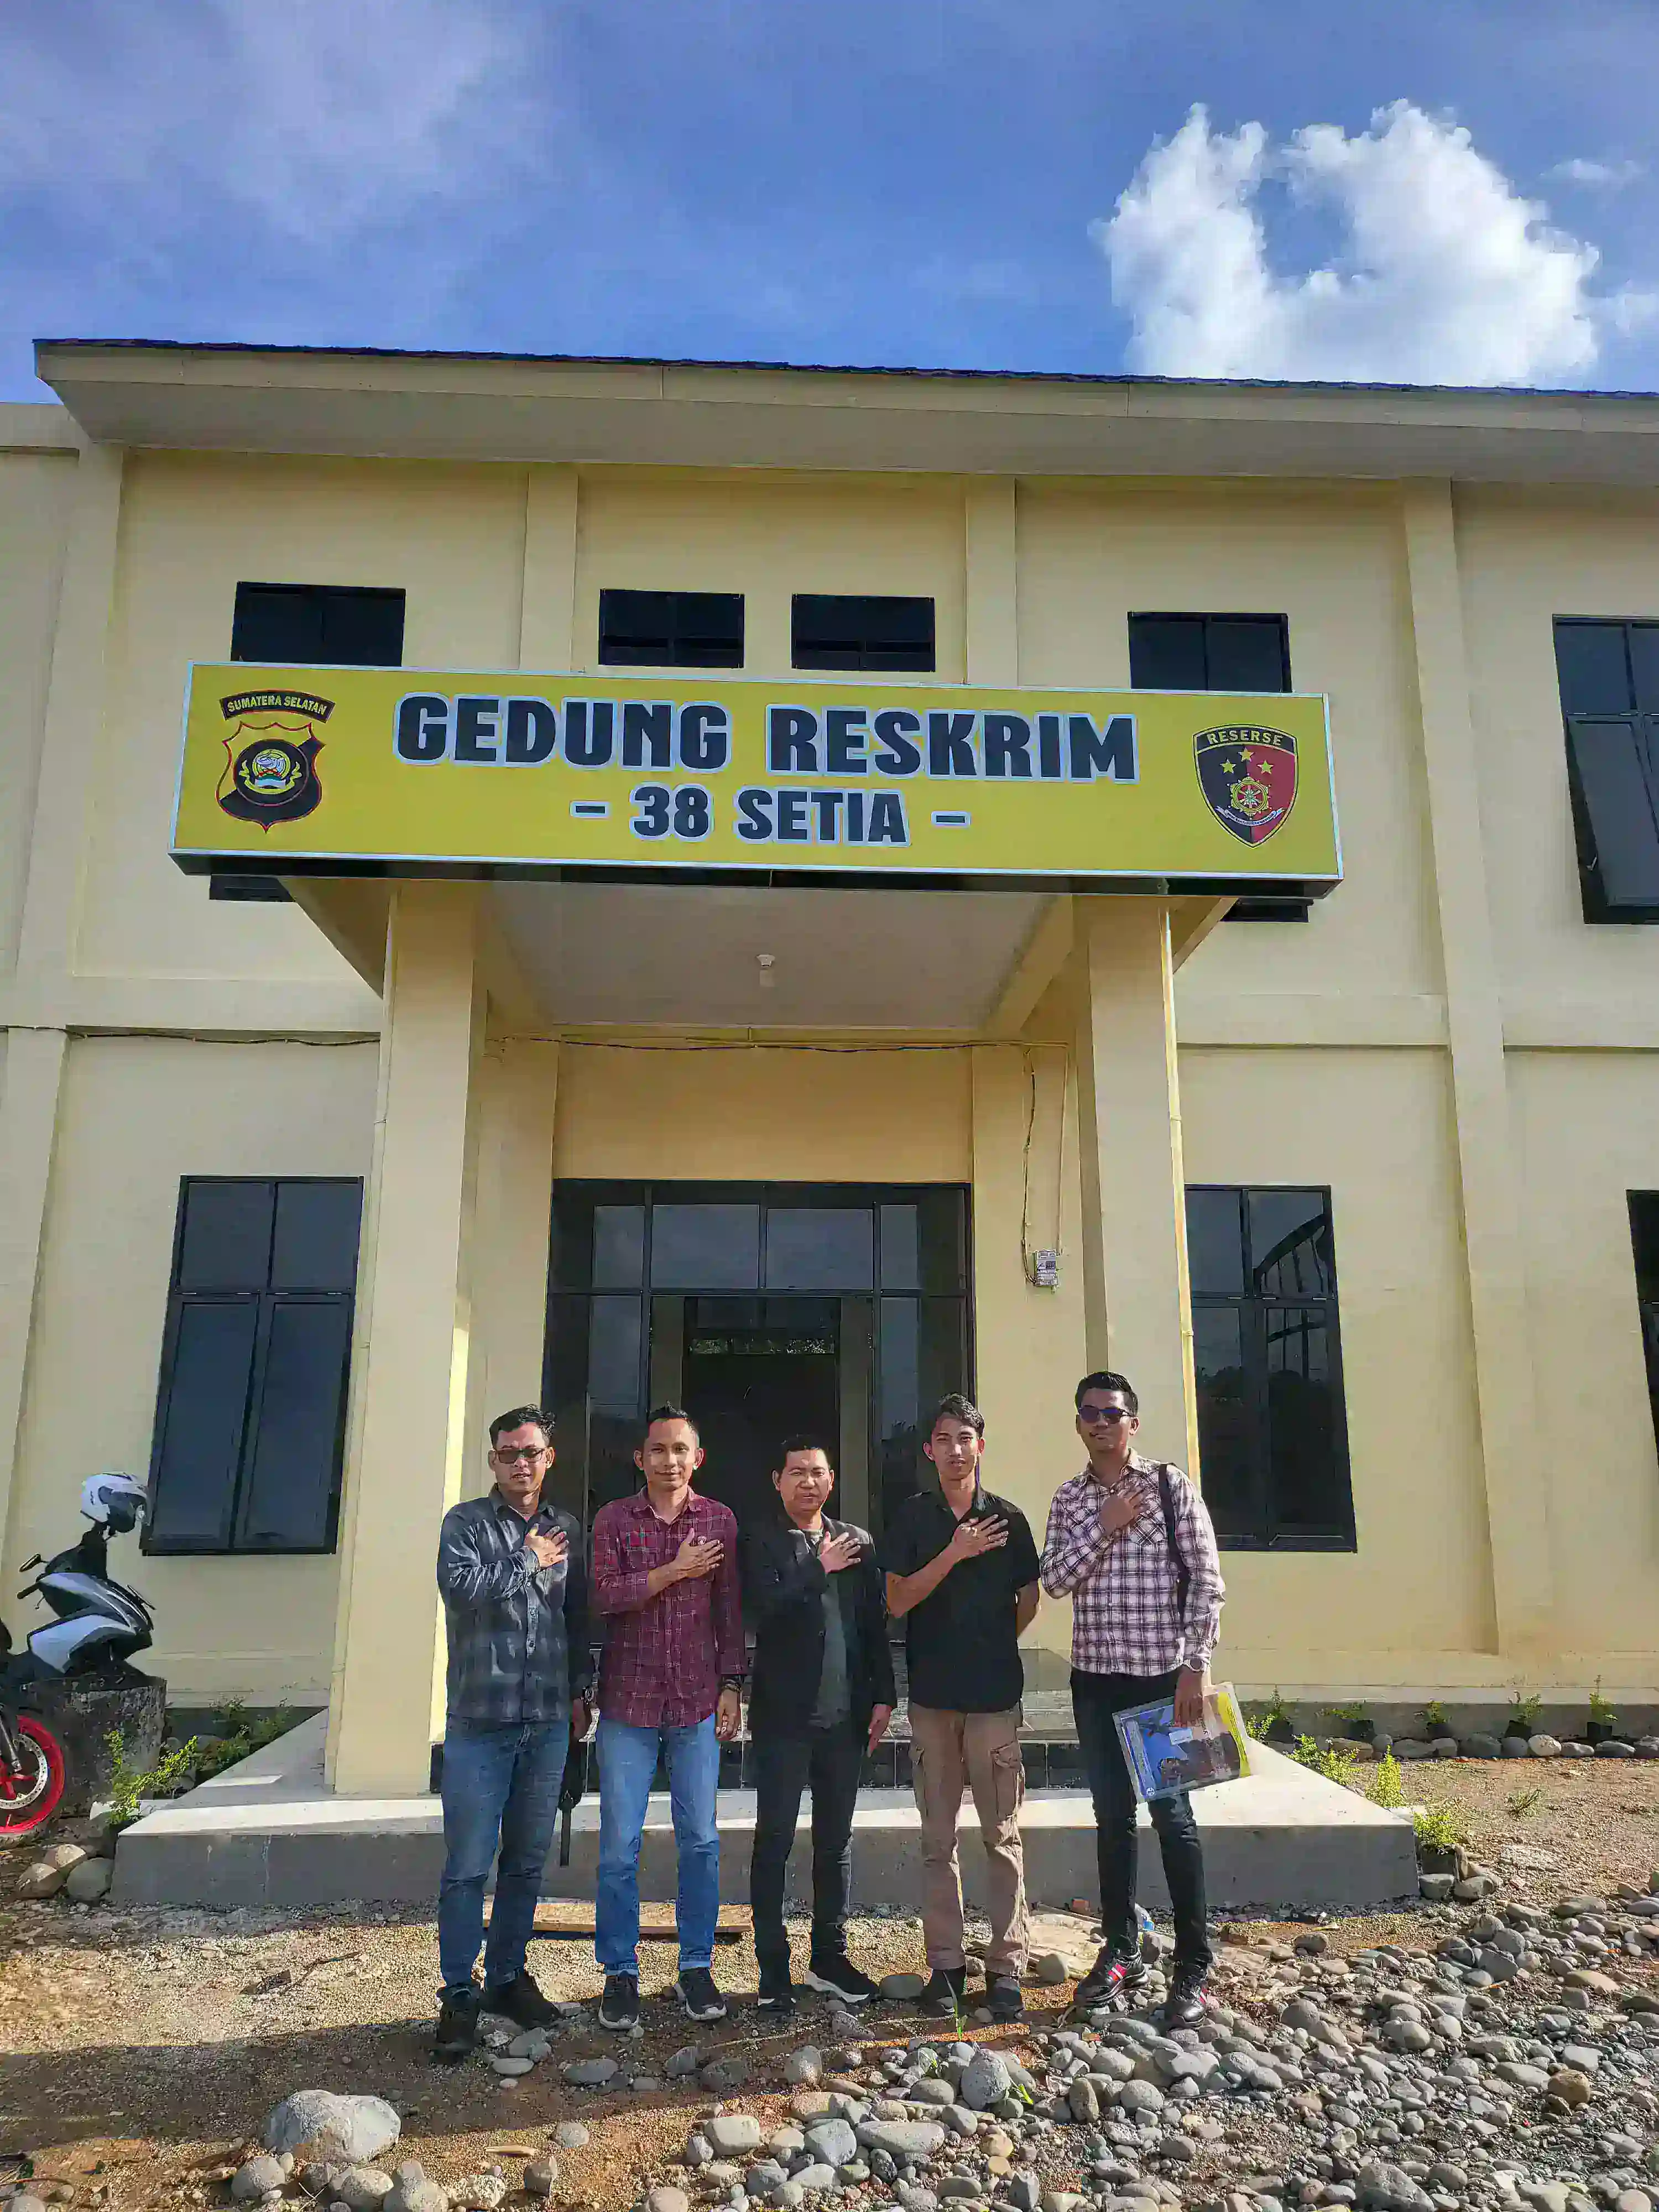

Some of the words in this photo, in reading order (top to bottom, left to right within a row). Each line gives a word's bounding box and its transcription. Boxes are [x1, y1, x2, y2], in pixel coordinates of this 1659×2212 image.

[227, 695, 281, 712] SUMATERA
[284, 696, 327, 716] SELATAN
[397, 695, 728, 770] GEDUNG
[769, 707, 1136, 780] RESKRIM
[1207, 729, 1284, 746] RESERSE
[632, 785, 710, 838] 38
[737, 789, 909, 843] SETIA
